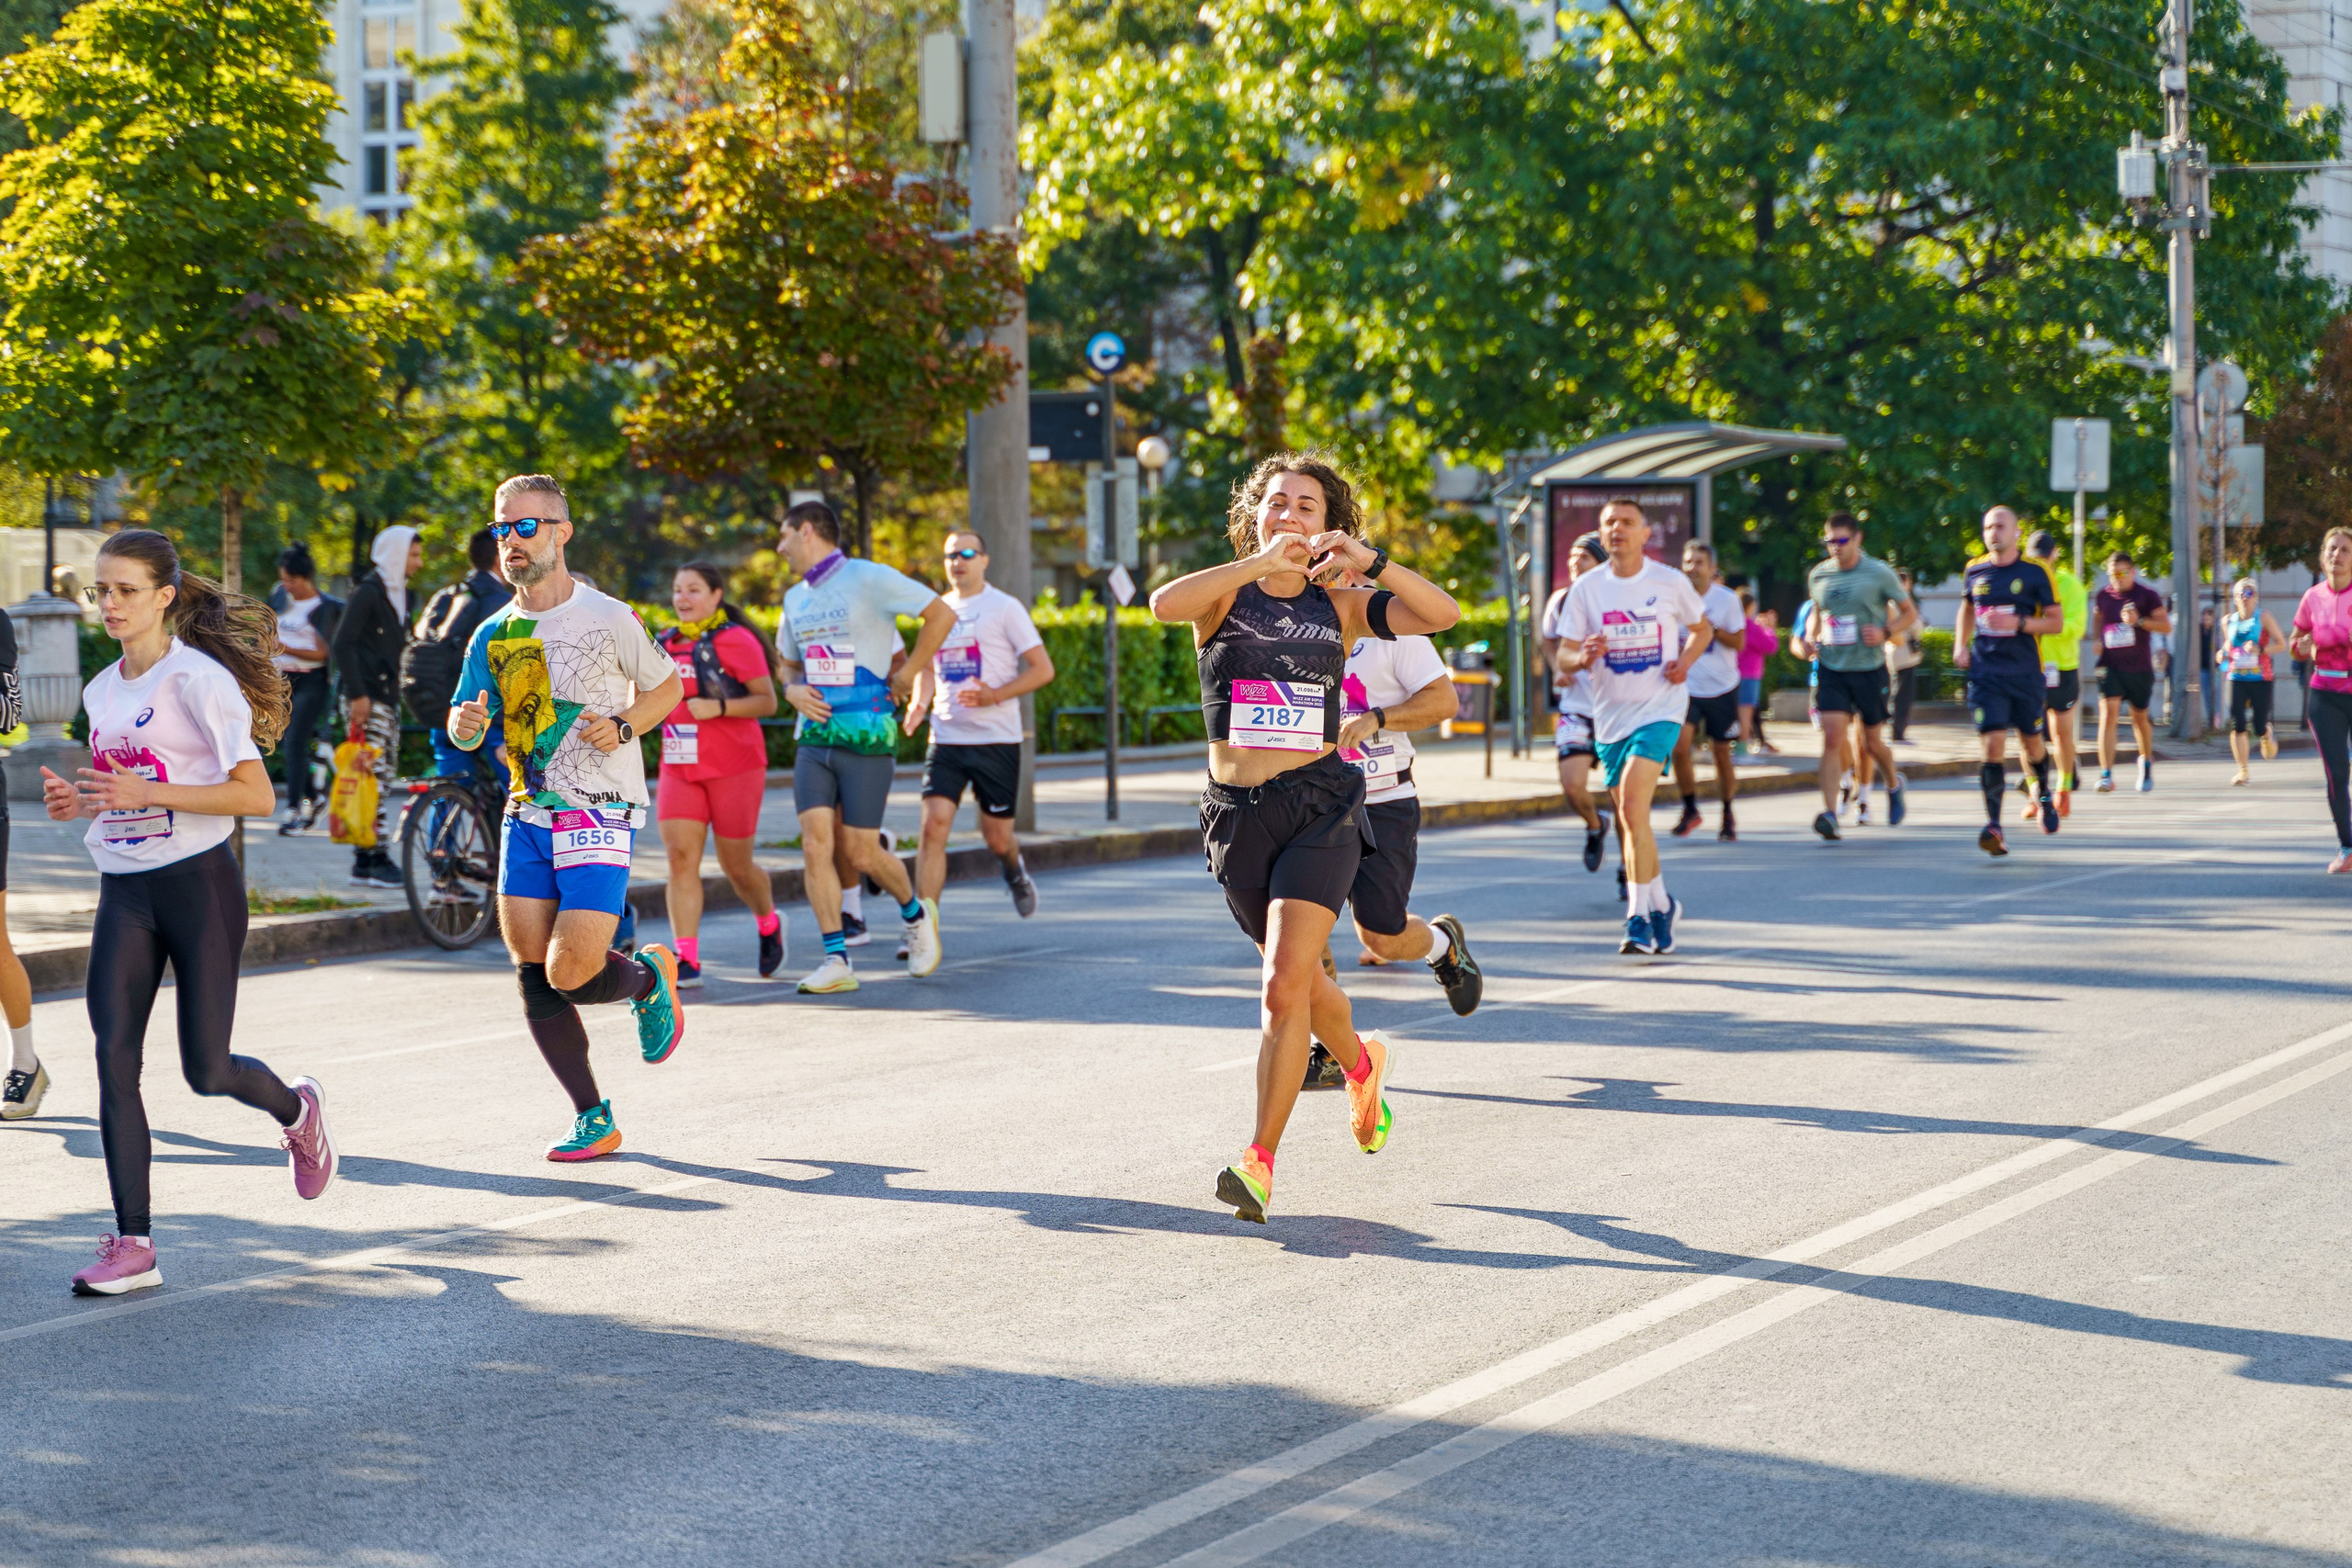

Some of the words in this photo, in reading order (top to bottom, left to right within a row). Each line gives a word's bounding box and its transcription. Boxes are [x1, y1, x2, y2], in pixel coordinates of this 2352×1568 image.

[1614, 625, 1645, 636] 1483
[817, 660, 836, 671] 101
[1252, 706, 1305, 727] 2187
[569, 829, 615, 847] 1656
